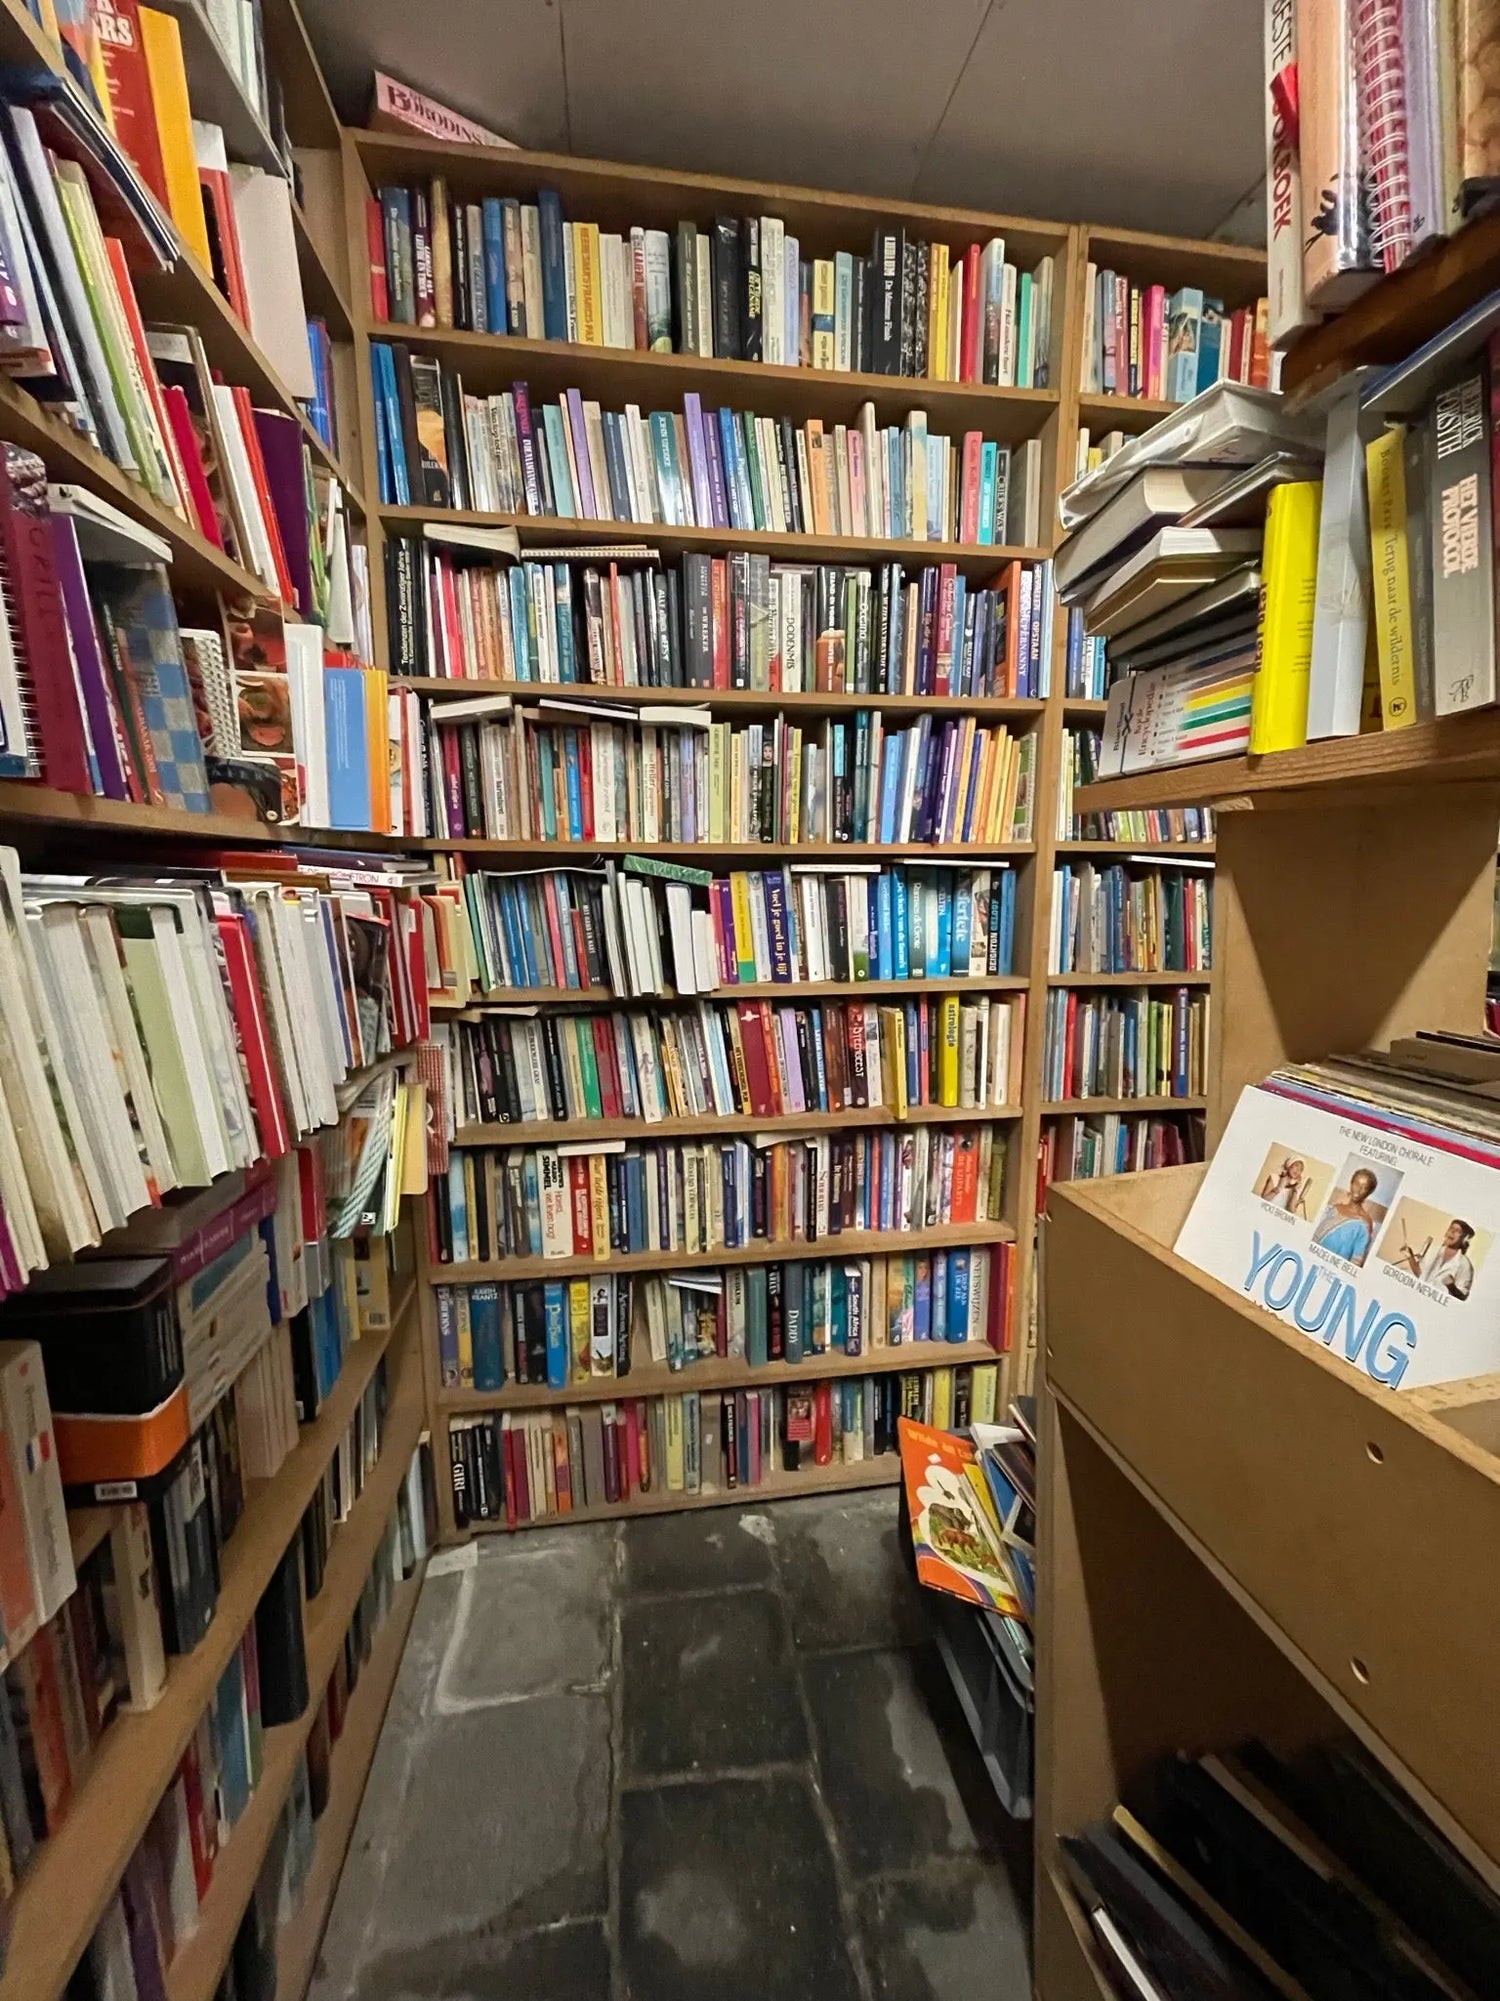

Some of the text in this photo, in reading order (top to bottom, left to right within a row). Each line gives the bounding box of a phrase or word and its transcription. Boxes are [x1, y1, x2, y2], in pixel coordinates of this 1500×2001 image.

[885, 280, 893, 289] De
[585, 325, 594, 342] PAX
[1435, 383, 1462, 461] FORSYTH
[996, 476, 1007, 532] CRIER'S WAR
[1441, 472, 1479, 580] HET VIERDE PROTOCOL
[397, 550, 405, 571] Jahre
[1383, 535, 1399, 575] Terug
[1387, 576, 1401, 606] naar
[1390, 607, 1402, 623] de
[399, 625, 409, 665] Tendenzen
[786, 617, 796, 670] DODENMIS
[1389, 626, 1402, 686] wildernis
[771, 908, 782, 917] je
[773, 919, 784, 940] goed
[774, 952, 785, 962] je
[776, 941, 784, 950] in
[989, 932, 998, 971] DEIGHTON
[947, 1004, 957, 1047] astrologie
[817, 1071, 825, 1093] LEVEN
[1339, 1125, 1435, 1167] THE NEW LONDON CHORALE
[1360, 1144, 1398, 1166] FEATURING
[542, 1155, 551, 1190] SIMMEL
[1260, 1203, 1297, 1226] VICKI BROWN
[1308, 1243, 1360, 1279] MADELINE BELL
[1382, 1265, 1450, 1308] GORDON NEVILLE
[852, 1294, 860, 1316] South
[1244, 1229, 1418, 1391] YOUNG
[788, 1309, 799, 1345] DADDY
[452, 1464, 465, 1491] GIRI
